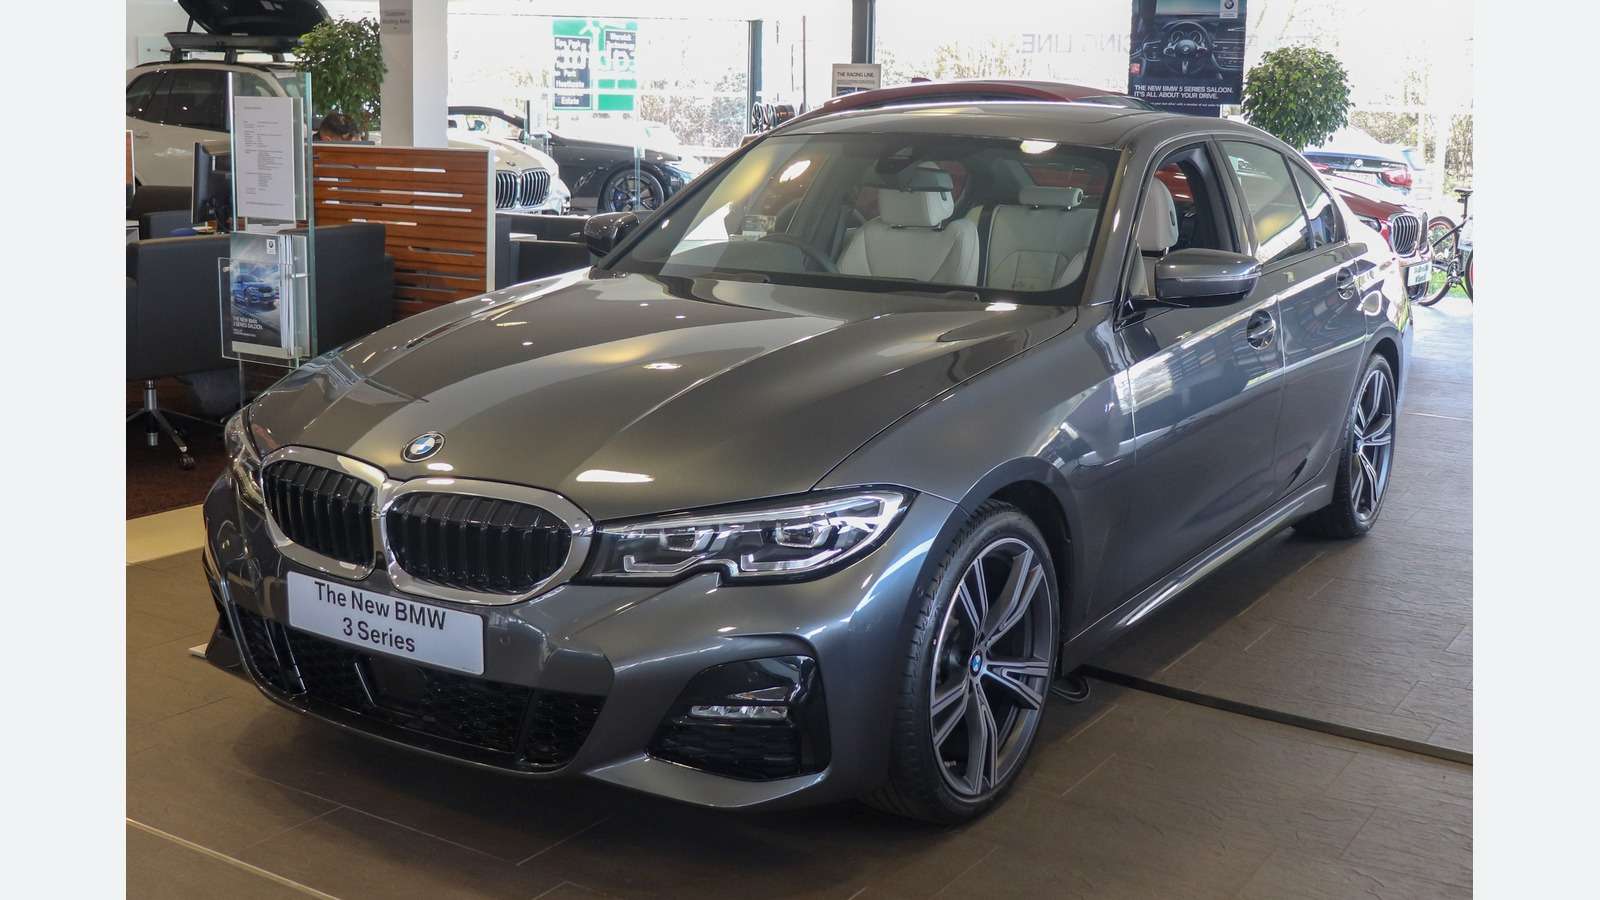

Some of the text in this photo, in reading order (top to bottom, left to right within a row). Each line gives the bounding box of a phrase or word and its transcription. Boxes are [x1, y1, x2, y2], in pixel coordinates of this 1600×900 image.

[314, 580, 447, 631] The New BMW
[342, 616, 416, 653] 3 Series
